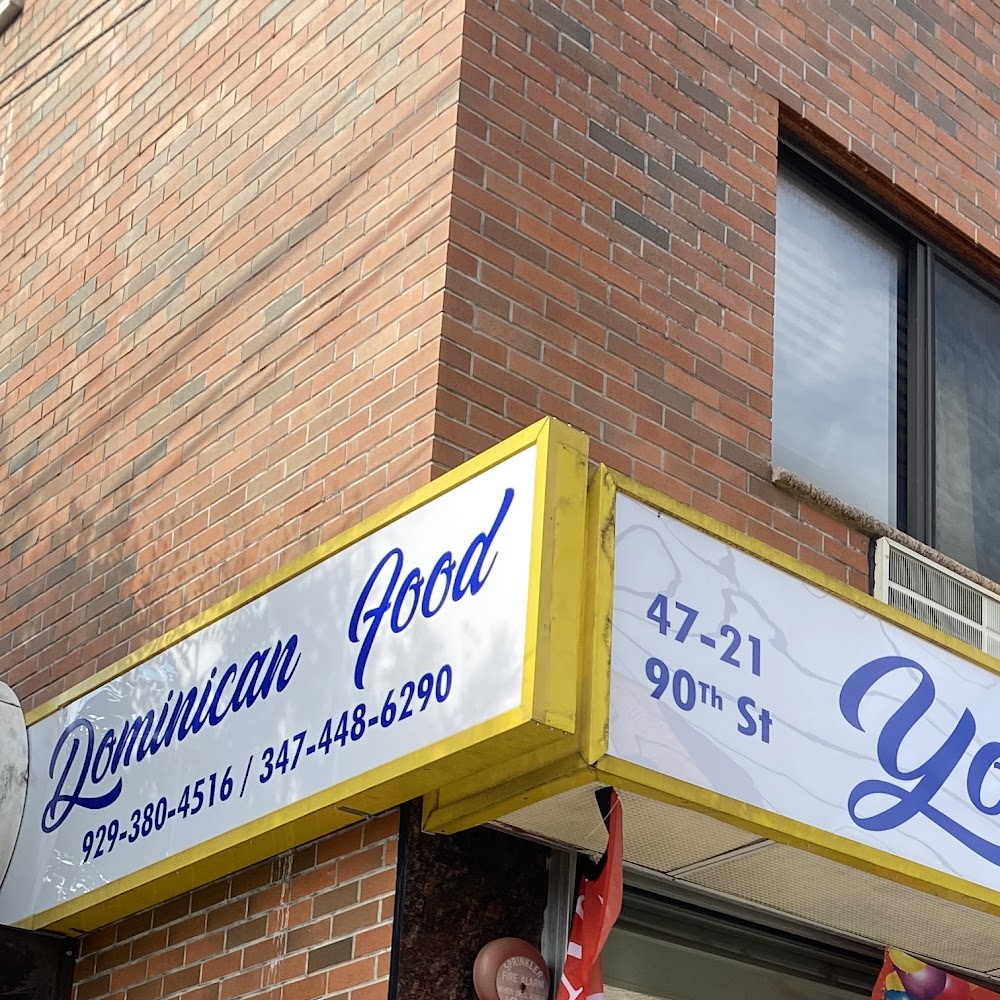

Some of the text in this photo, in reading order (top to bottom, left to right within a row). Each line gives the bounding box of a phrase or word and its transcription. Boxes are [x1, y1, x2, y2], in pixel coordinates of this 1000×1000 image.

[41, 487, 515, 833] Dominican Food
[646, 593, 763, 678] 47-21
[736, 696, 774, 745] St
[81, 765, 234, 863] 929-380-4516
[259, 663, 453, 784] 347-448-6290
[502, 970, 545, 989] FIRE ALARM
[503, 956, 544, 978] SPRINKLER
